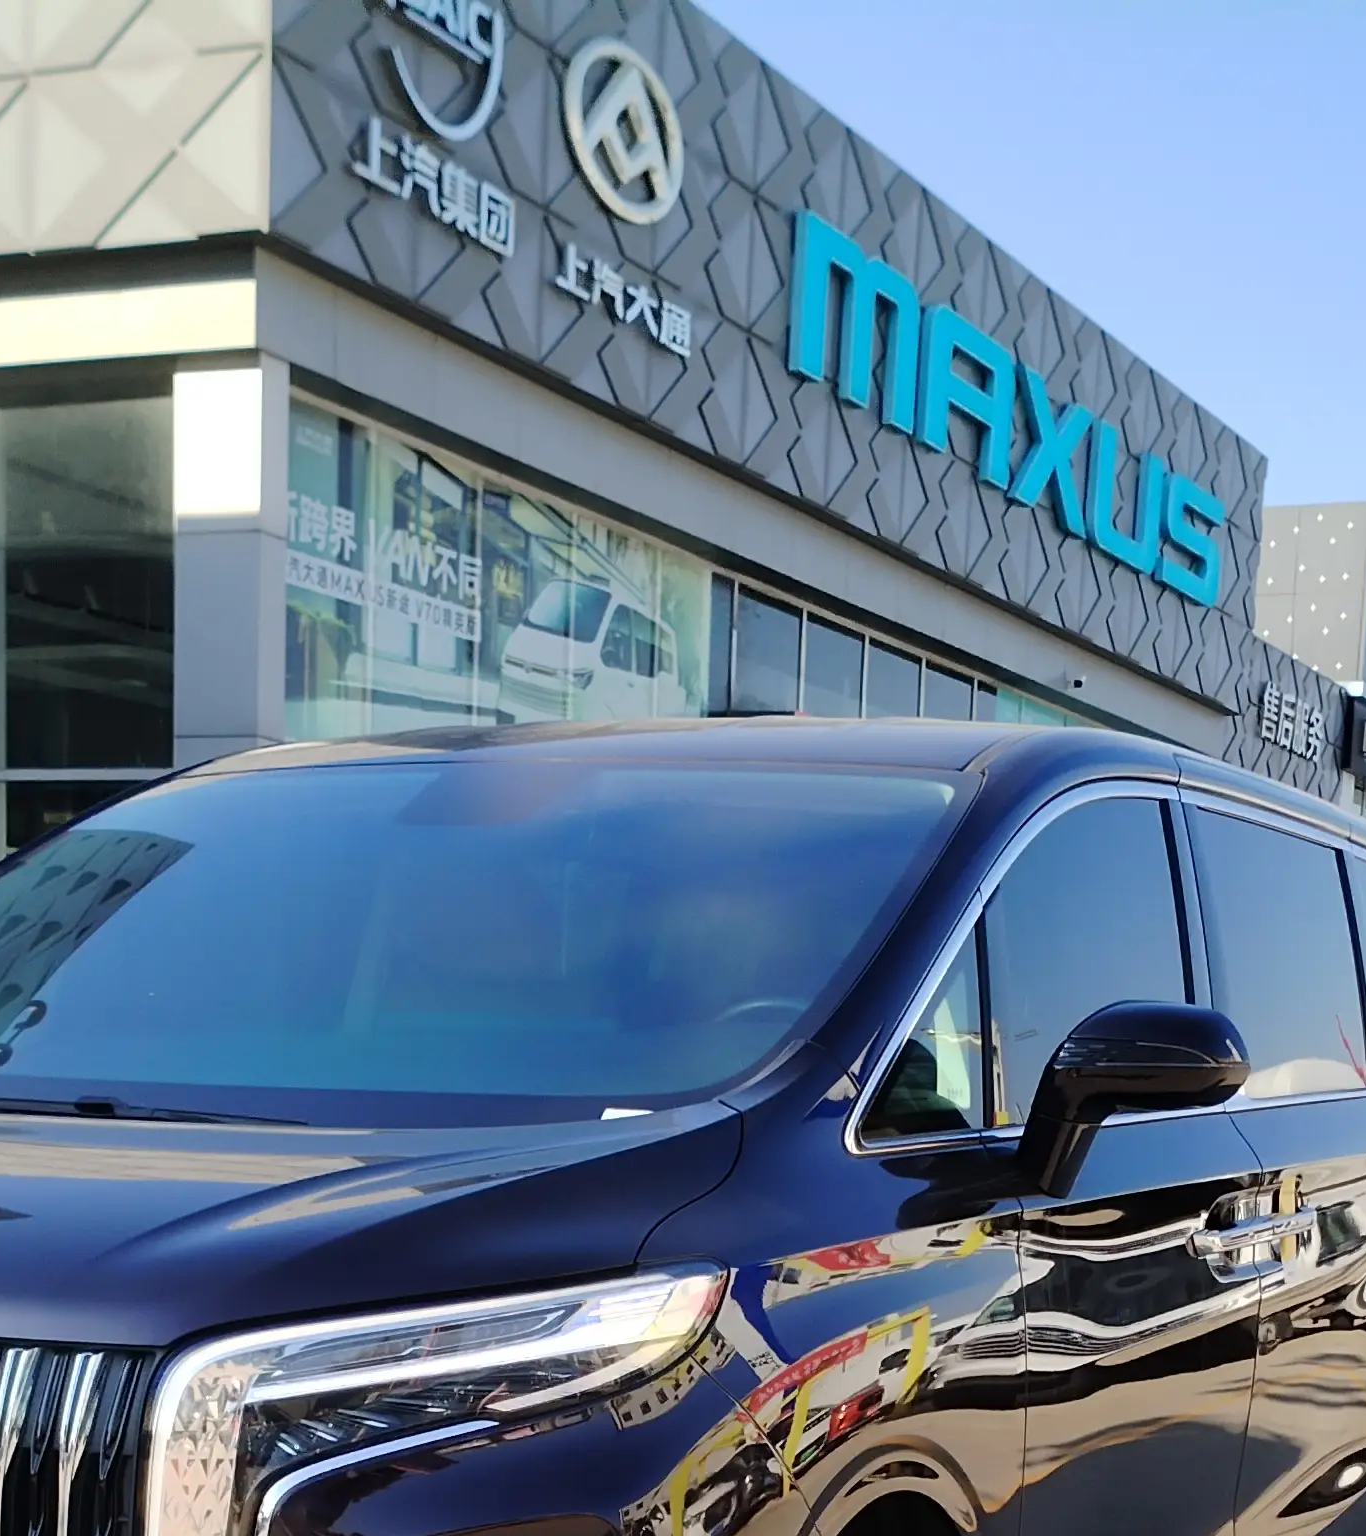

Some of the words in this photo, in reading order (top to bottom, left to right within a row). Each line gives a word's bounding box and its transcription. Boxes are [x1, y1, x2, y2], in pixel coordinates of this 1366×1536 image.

[351, 116, 515, 258] 上汽集团
[555, 243, 691, 358] 上汽大通
[786, 210, 1226, 609] MAXUS
[1261, 681, 1324, 763] 售后服务
